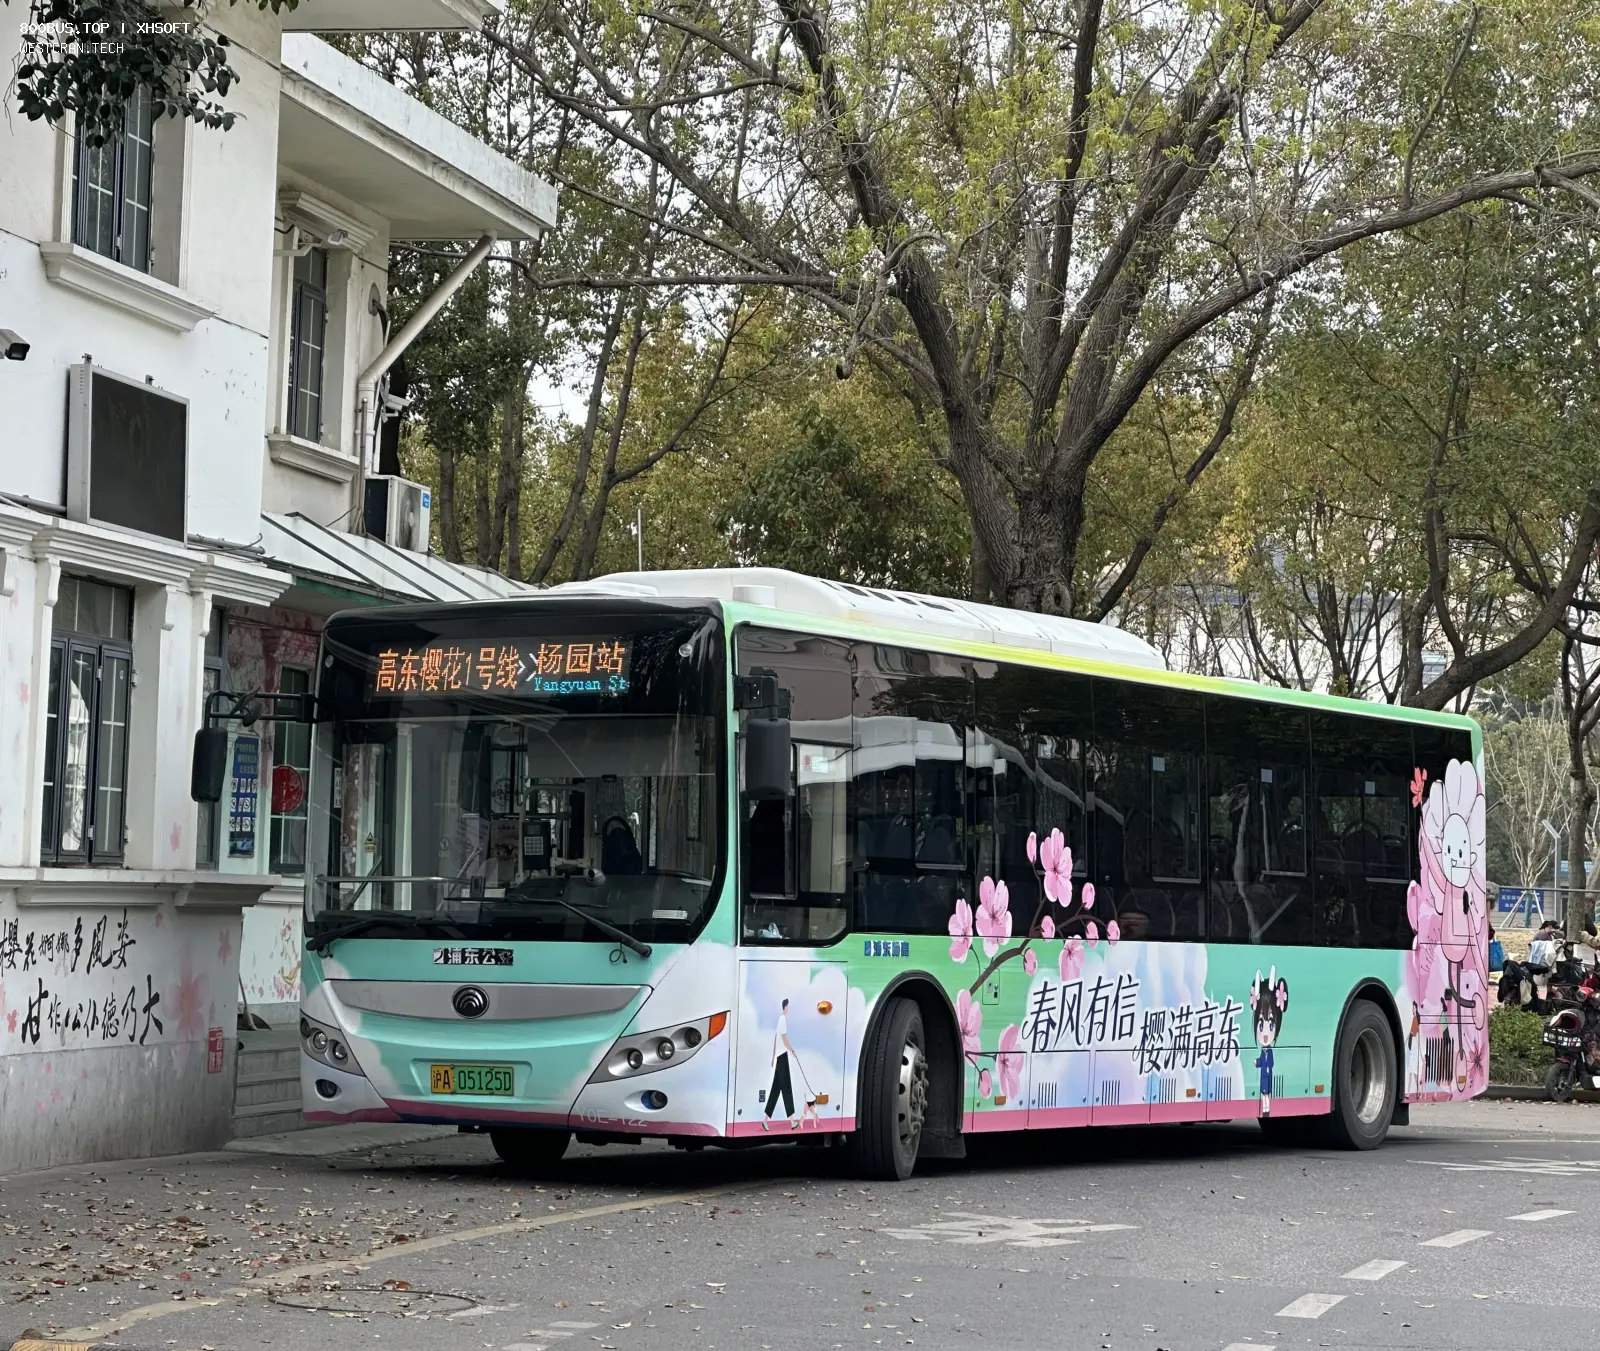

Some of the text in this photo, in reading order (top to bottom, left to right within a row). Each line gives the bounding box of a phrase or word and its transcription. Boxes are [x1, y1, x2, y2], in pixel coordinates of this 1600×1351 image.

[376, 641, 626, 692] 高东樱花1号线 杨园站
[534, 677, 601, 693] Yangyuan
[1021, 973, 1140, 1052] 春风有信
[1132, 997, 1243, 1075] 樱满高东
